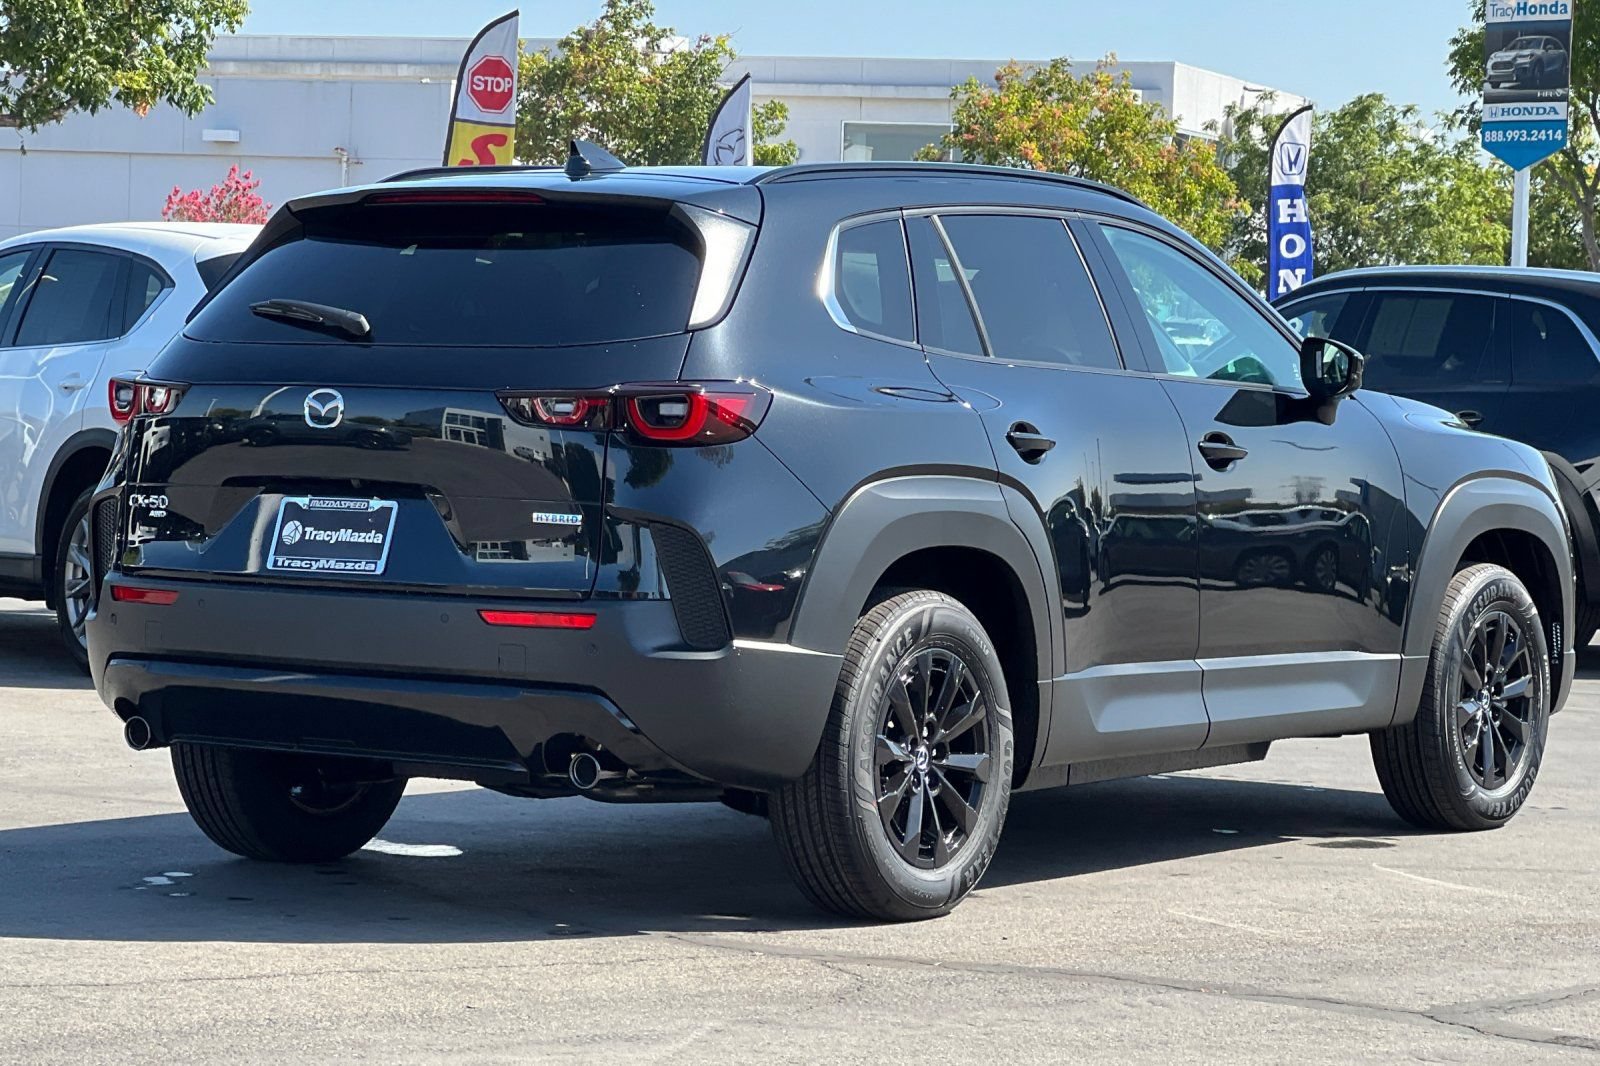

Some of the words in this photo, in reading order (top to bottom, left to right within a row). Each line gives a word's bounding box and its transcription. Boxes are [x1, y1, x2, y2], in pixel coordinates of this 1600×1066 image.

[1490, 1, 1568, 20] TracyHonda
[472, 75, 513, 93] STOP
[1500, 106, 1560, 117] HONDA
[1484, 129, 1563, 142] 888.993.2414
[129, 494, 169, 509] CX-50
[310, 499, 369, 509] MAZDASPEED
[149, 510, 167, 518] AWD
[536, 514, 578, 524] HYBRID
[304, 526, 383, 544] TracyMazda
[275, 557, 376, 571] TracyMazda
